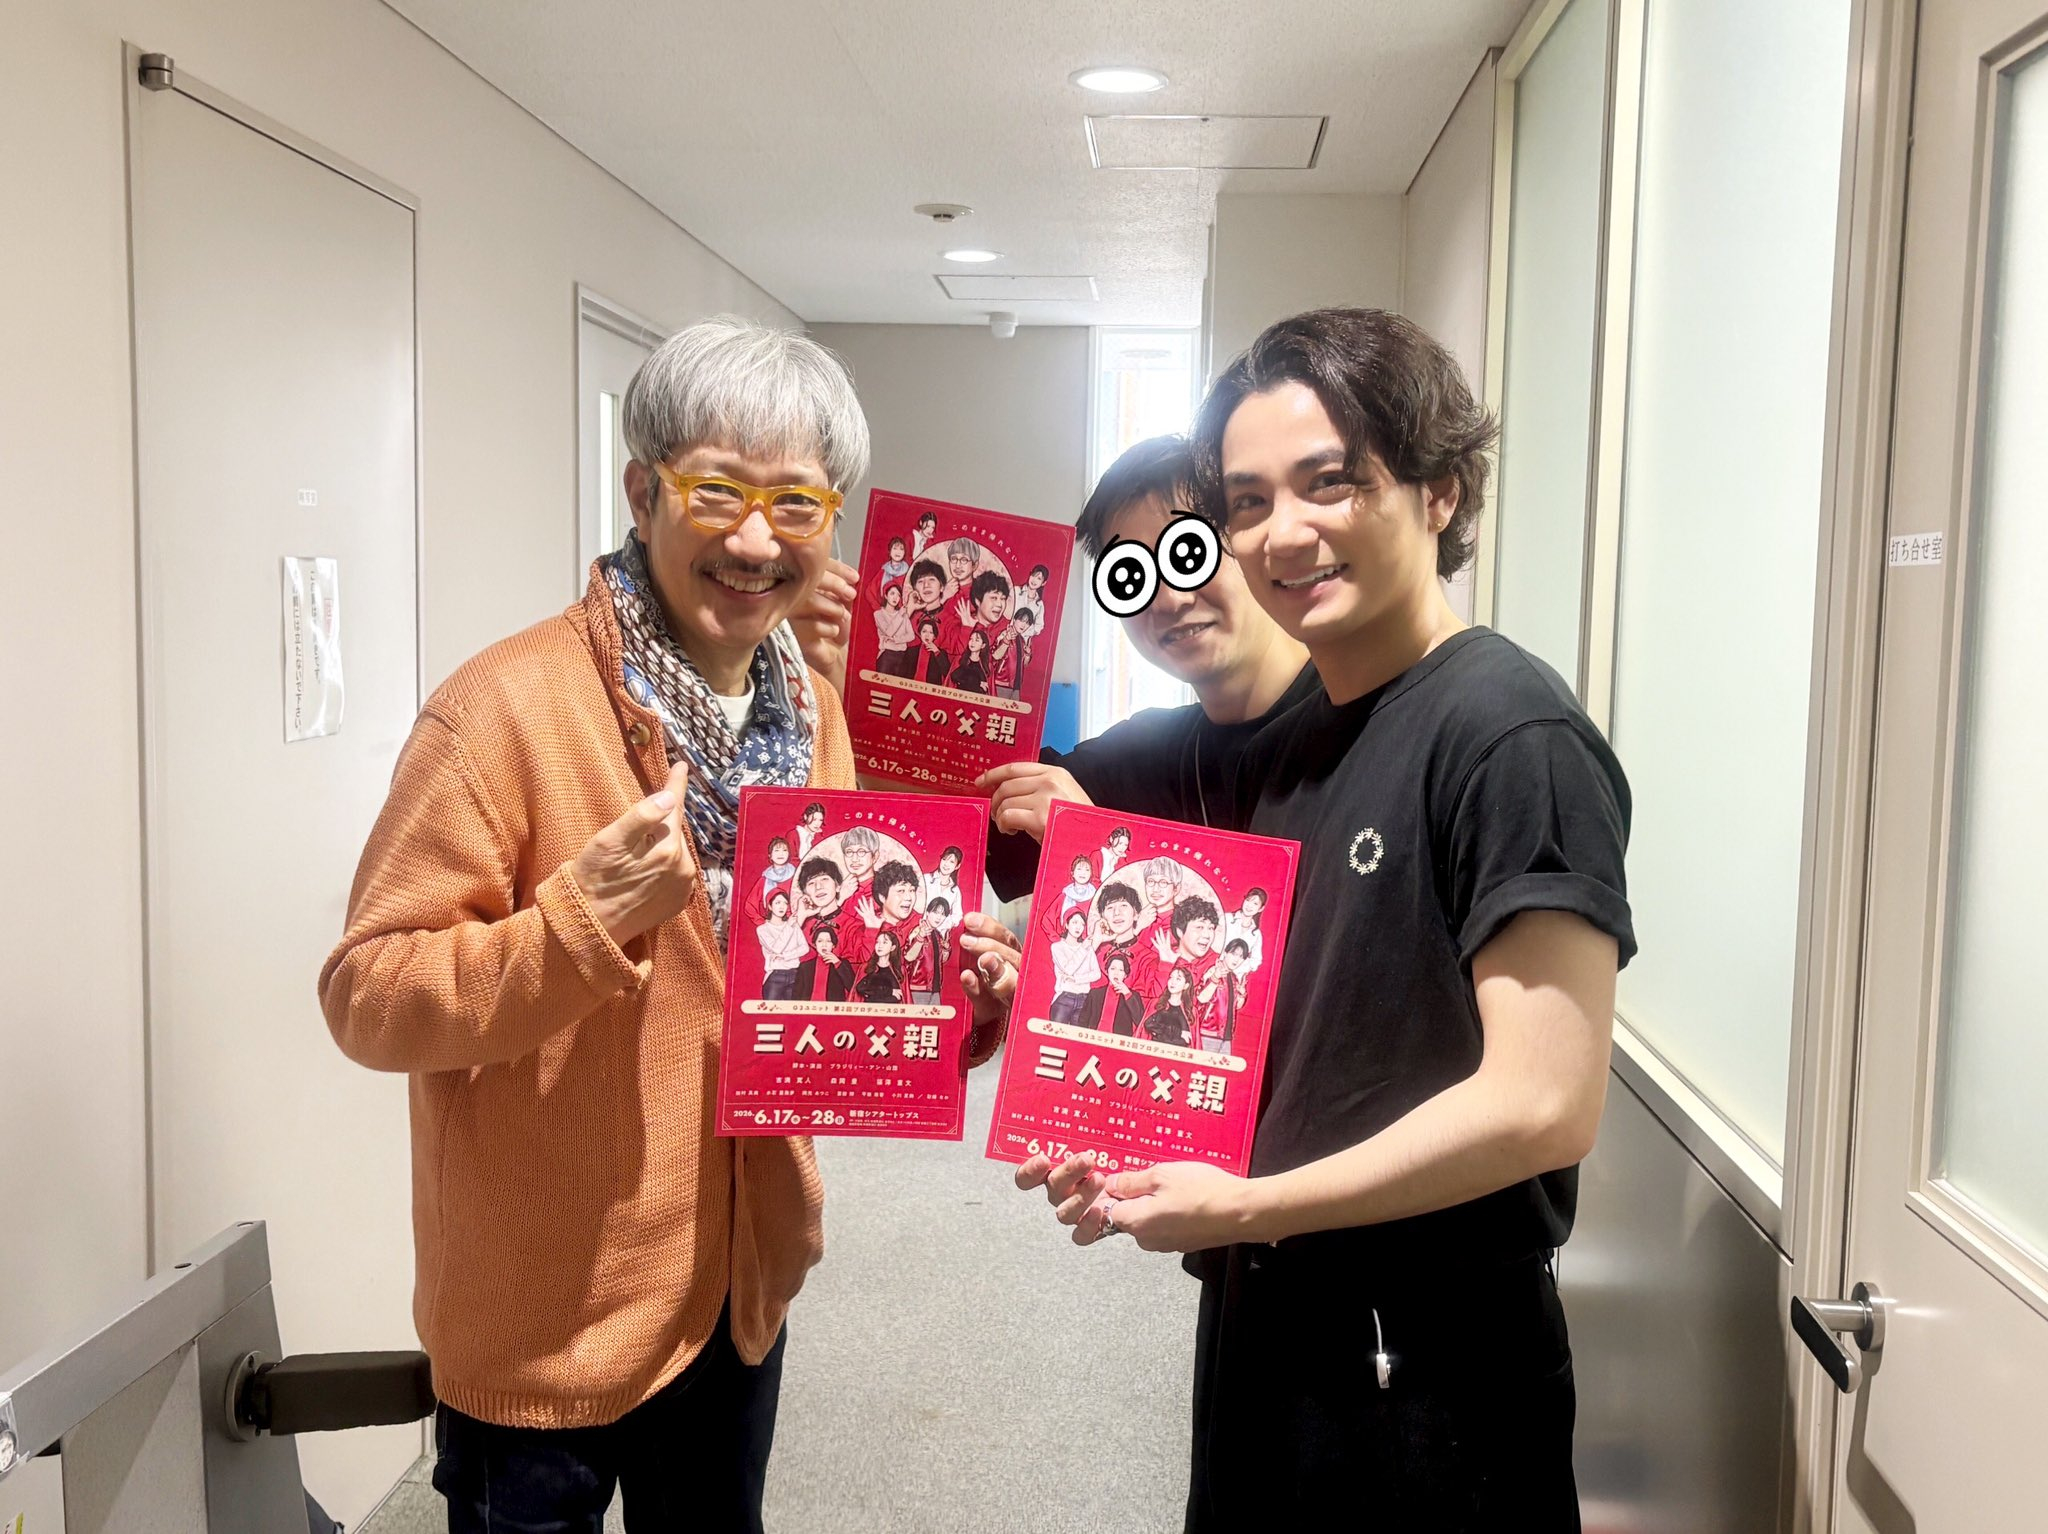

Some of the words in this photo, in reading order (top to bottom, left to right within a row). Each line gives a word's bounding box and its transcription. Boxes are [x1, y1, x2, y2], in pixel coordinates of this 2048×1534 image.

[1890, 536, 1942, 562] 打ち合せ室
[867, 689, 1017, 747] 三人の父親
[753, 1022, 940, 1061] 三人の父親
[1034, 1045, 1228, 1115] 三人の父親
[849, 1109, 919, 1119] 新宿シアタートップス
